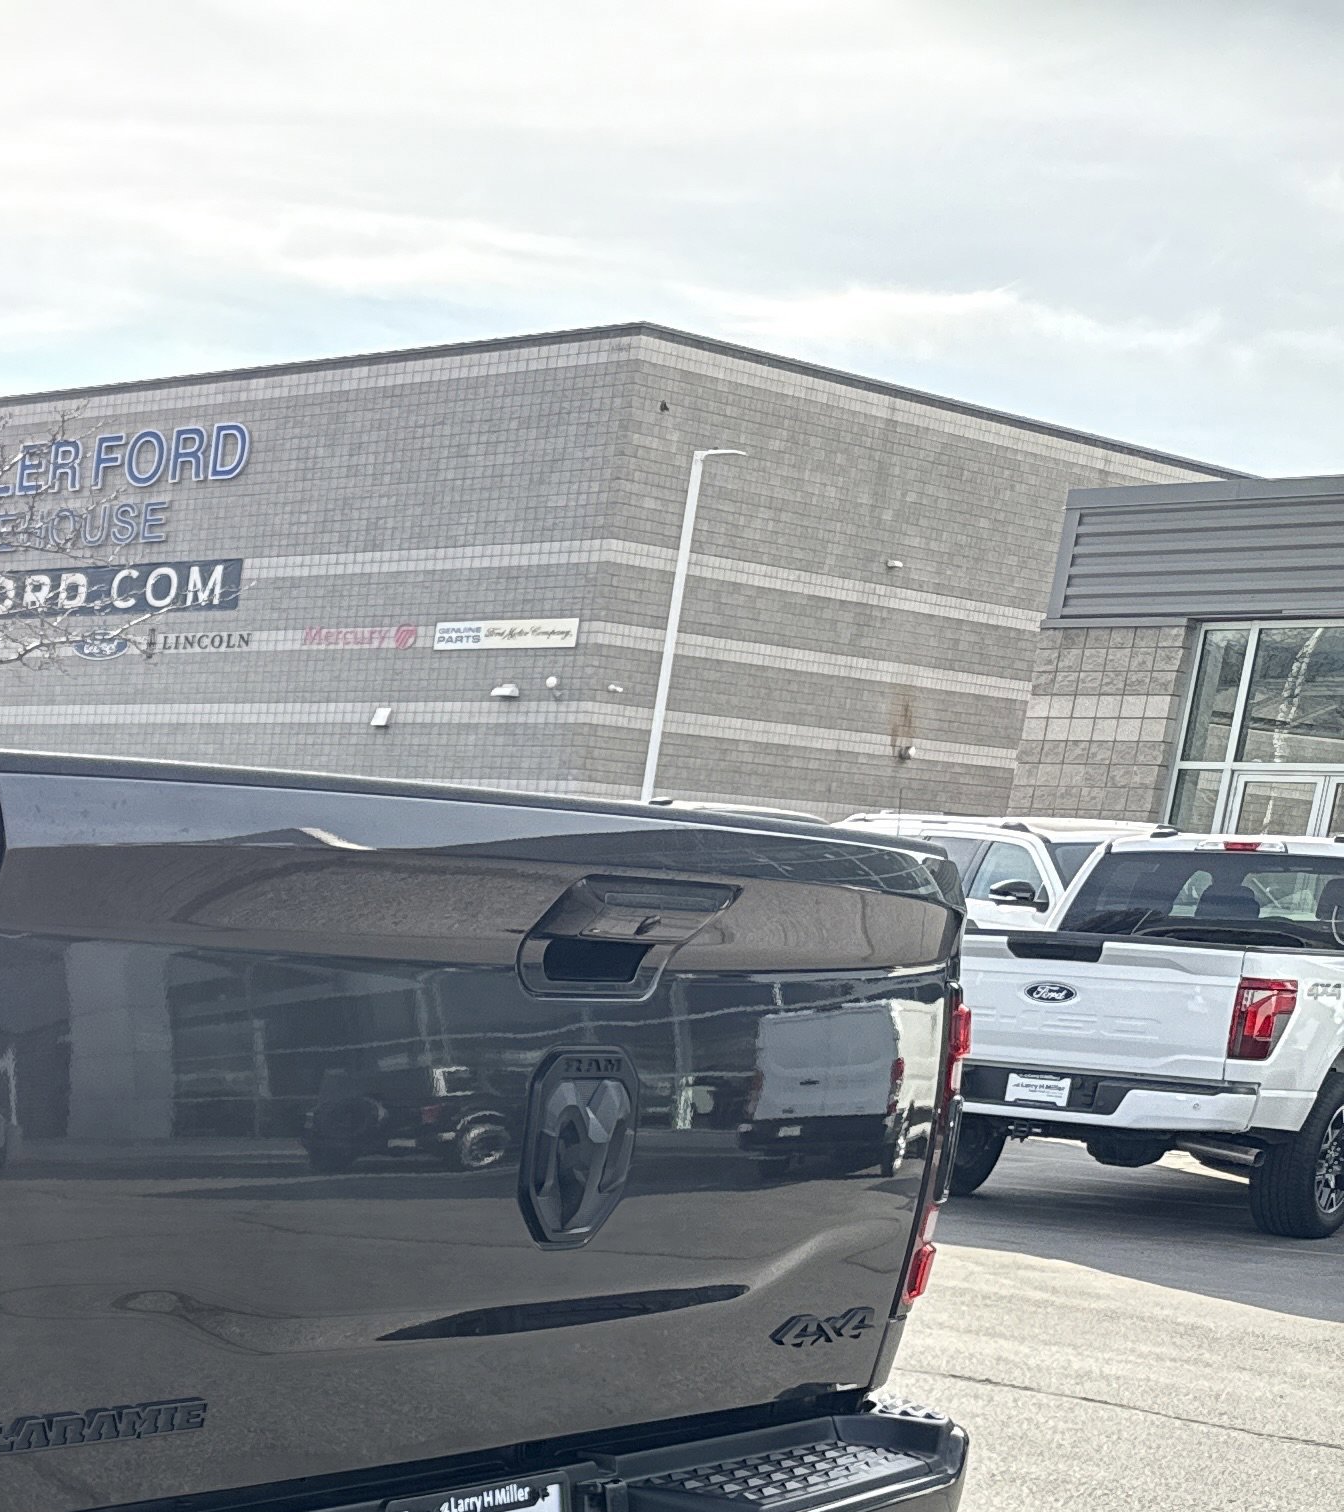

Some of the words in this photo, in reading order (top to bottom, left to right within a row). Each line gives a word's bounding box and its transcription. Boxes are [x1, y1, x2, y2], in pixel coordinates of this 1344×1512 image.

[90, 422, 250, 489] FORD
[302, 623, 390, 648] Mercury
[438, 626, 482, 635] GENUINE
[162, 632, 253, 650] LINCOLN
[436, 634, 481, 645] PARTS
[1032, 984, 1066, 1001] Ford
[564, 1057, 623, 1074] RAM
[1021, 1082, 1039, 1090] Larry
[450, 1495, 482, 1512] Larry
[483, 1491, 493, 1507] H
[494, 1484, 529, 1506] Miller
